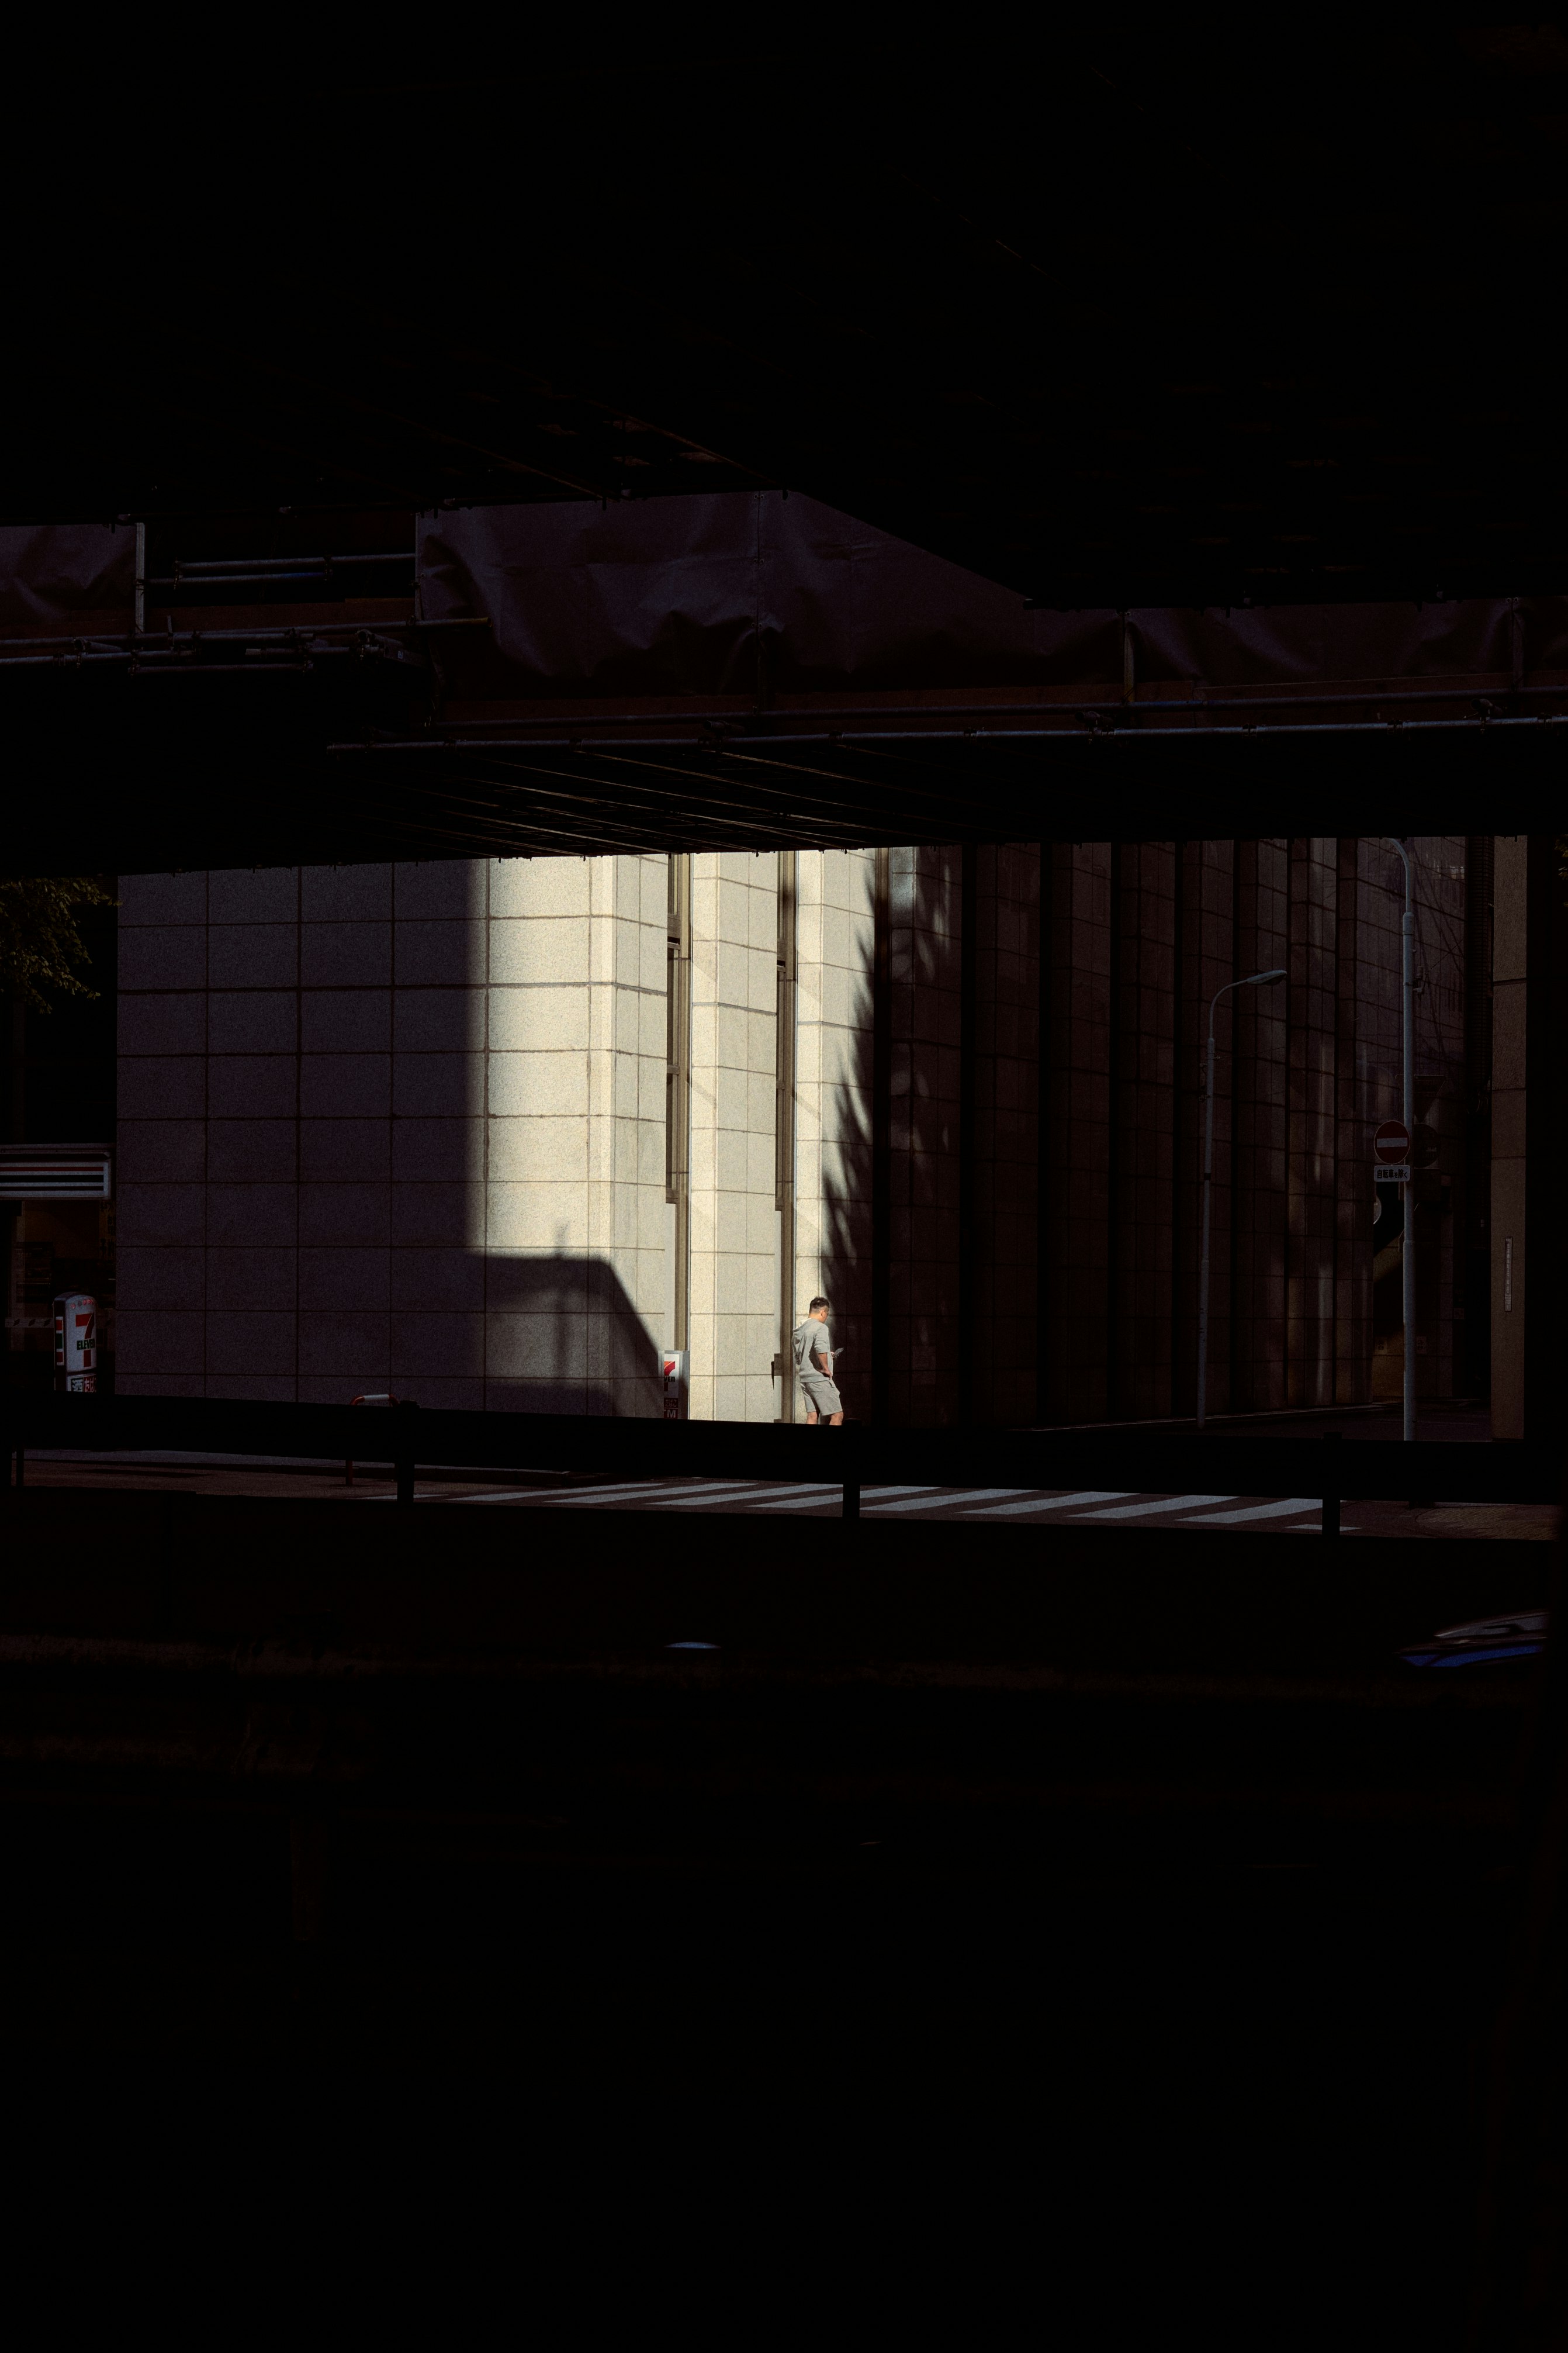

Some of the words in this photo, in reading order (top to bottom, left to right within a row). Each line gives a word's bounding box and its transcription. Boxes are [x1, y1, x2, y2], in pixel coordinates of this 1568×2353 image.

[1377, 1169, 1407, 1179] 自転車を除く
[76, 1312, 95, 1367] 7
